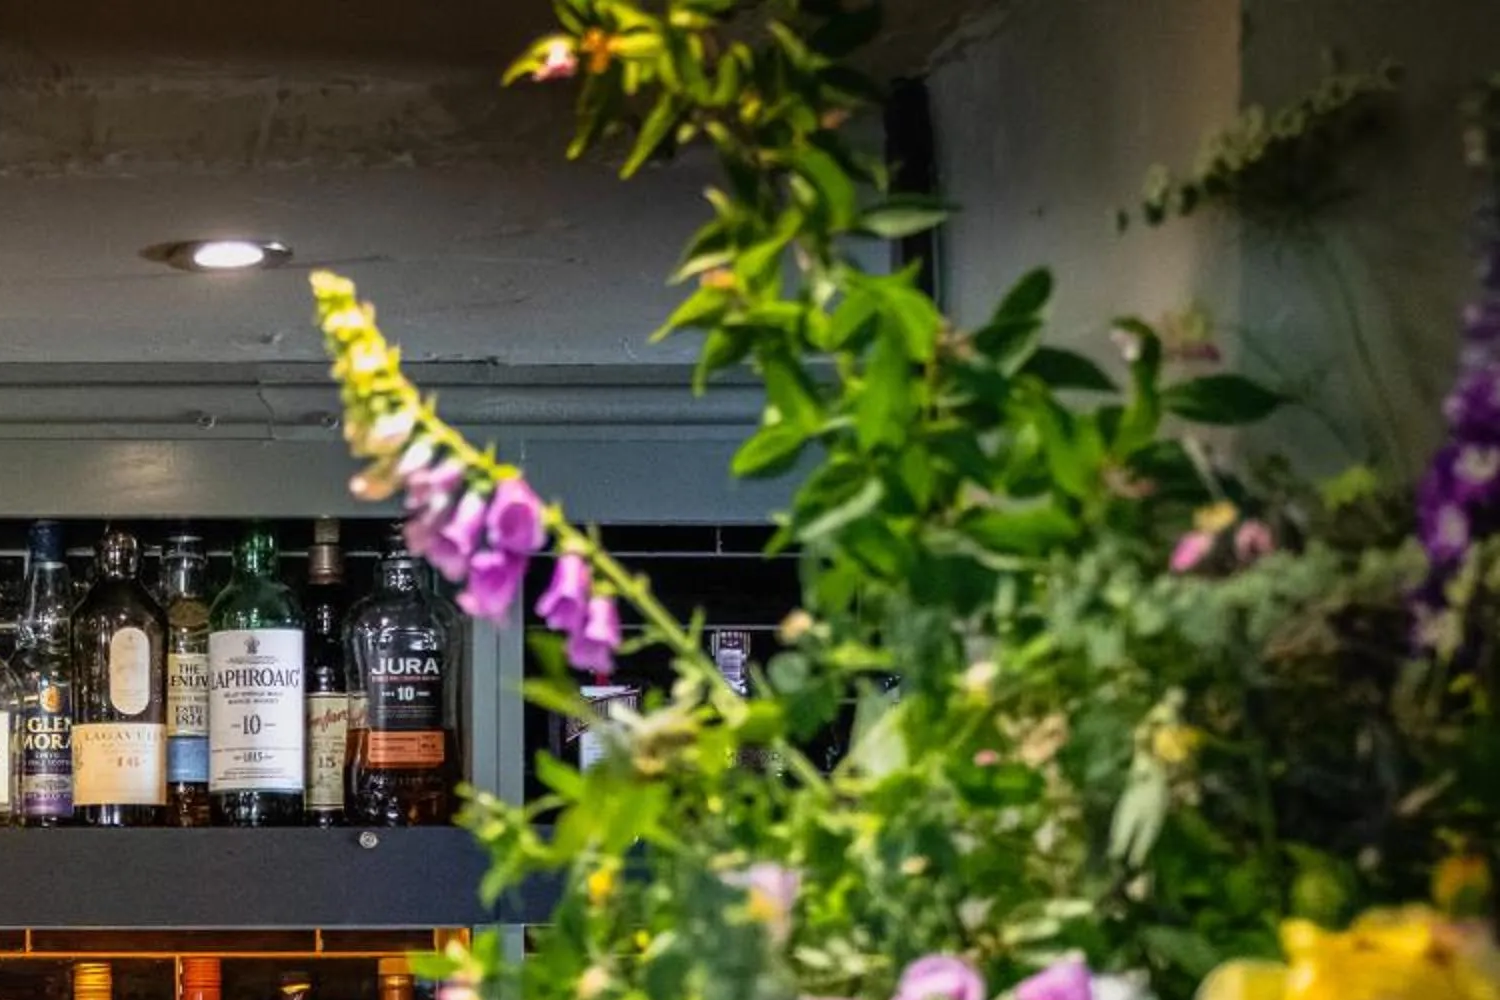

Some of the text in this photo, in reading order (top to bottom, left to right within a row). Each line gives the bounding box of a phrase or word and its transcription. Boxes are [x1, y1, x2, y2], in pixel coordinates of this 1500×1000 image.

[178, 663, 200, 674] THE
[371, 656, 440, 675] JURA
[171, 675, 210, 687] ENLIV
[210, 667, 300, 690] LAPHROAIG
[397, 686, 415, 702] 10
[27, 716, 71, 733] GLEN
[242, 714, 261, 735] 10
[23, 733, 71, 750] MORA
